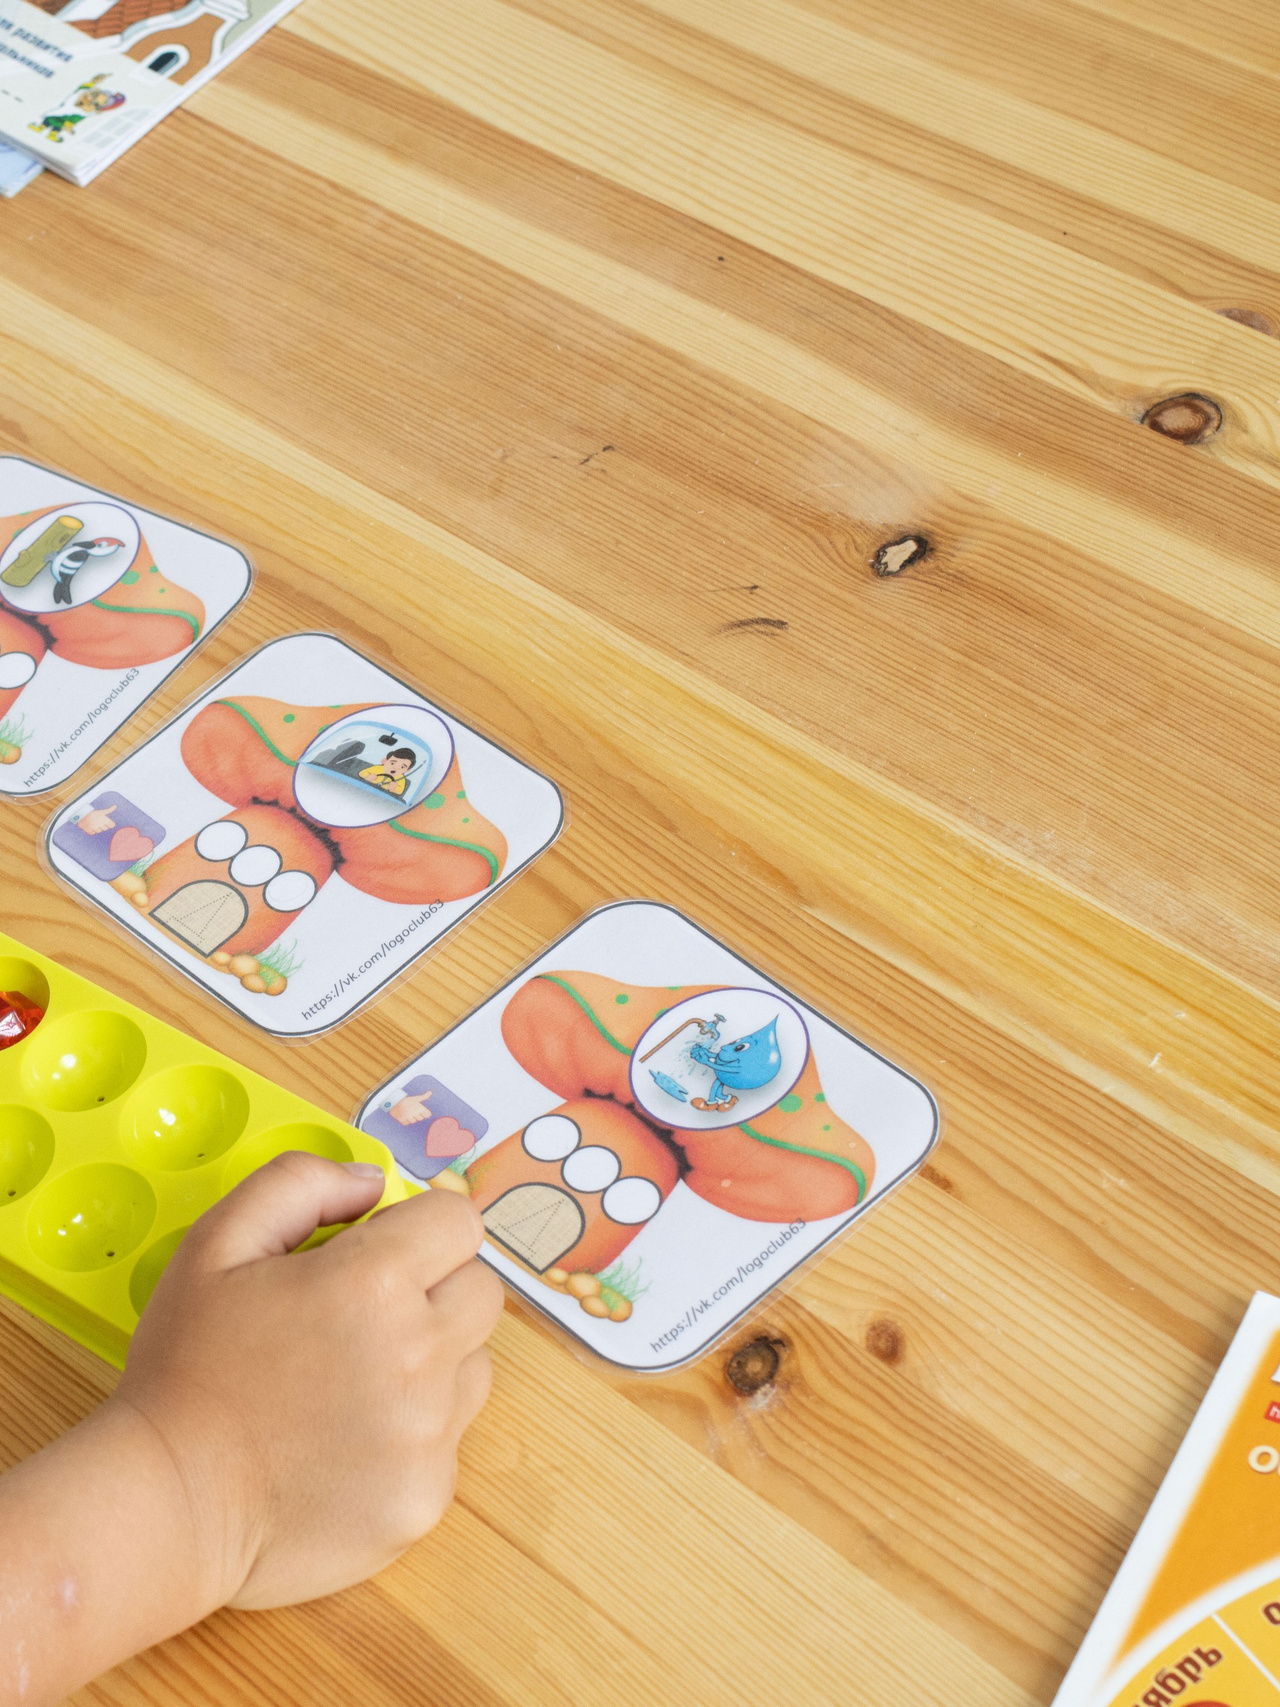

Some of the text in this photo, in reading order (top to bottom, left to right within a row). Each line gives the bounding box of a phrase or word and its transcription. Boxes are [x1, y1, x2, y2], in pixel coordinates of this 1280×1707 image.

[23, 667, 140, 788] https://vk.com/logoclub63
[301, 898, 445, 1021] https://vk.com/logoclub63
[649, 1217, 807, 1353] https://vk.com/logoclub63
[1133, 1646, 1223, 1707] ябрь
